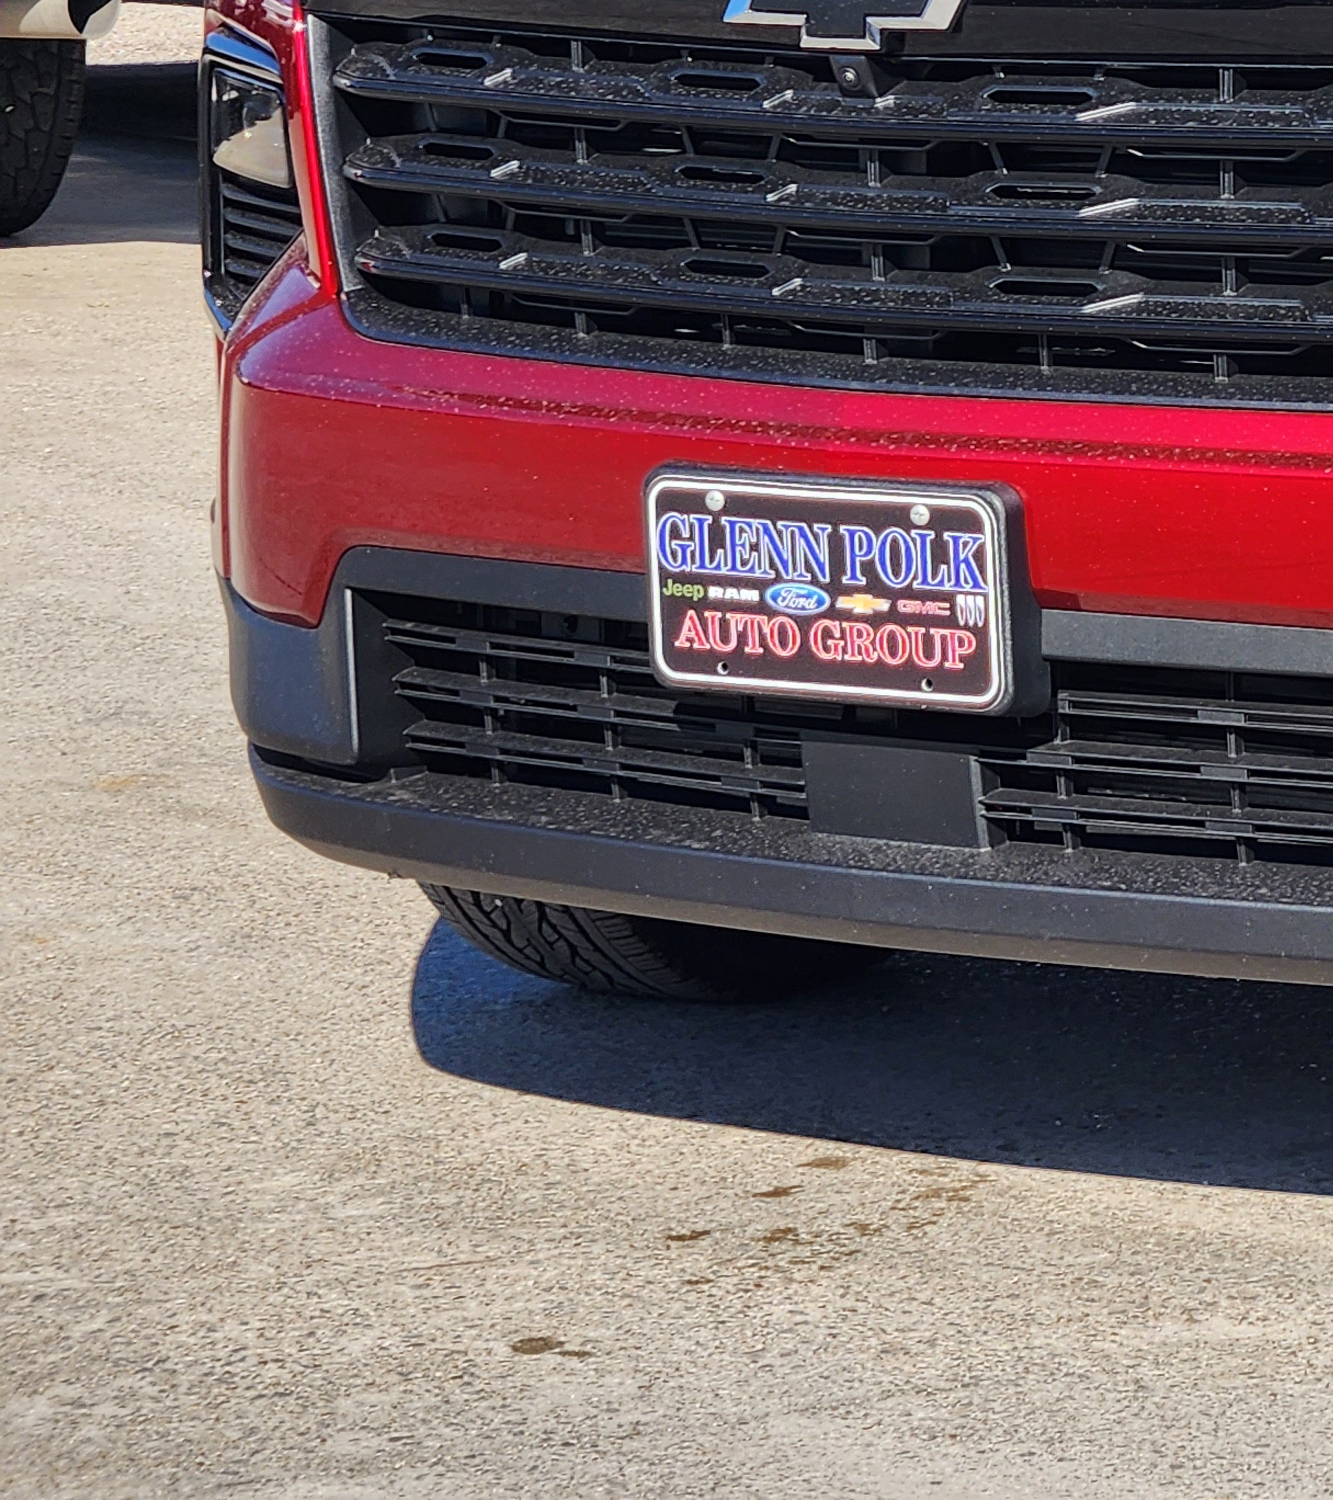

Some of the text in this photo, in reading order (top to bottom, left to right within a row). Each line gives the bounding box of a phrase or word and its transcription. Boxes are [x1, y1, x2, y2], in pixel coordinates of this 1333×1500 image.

[657, 511, 989, 594] GLENN POLK
[662, 578, 951, 616] Jeep RAM Ford GMC
[674, 609, 978, 670] AUTO GROUP
